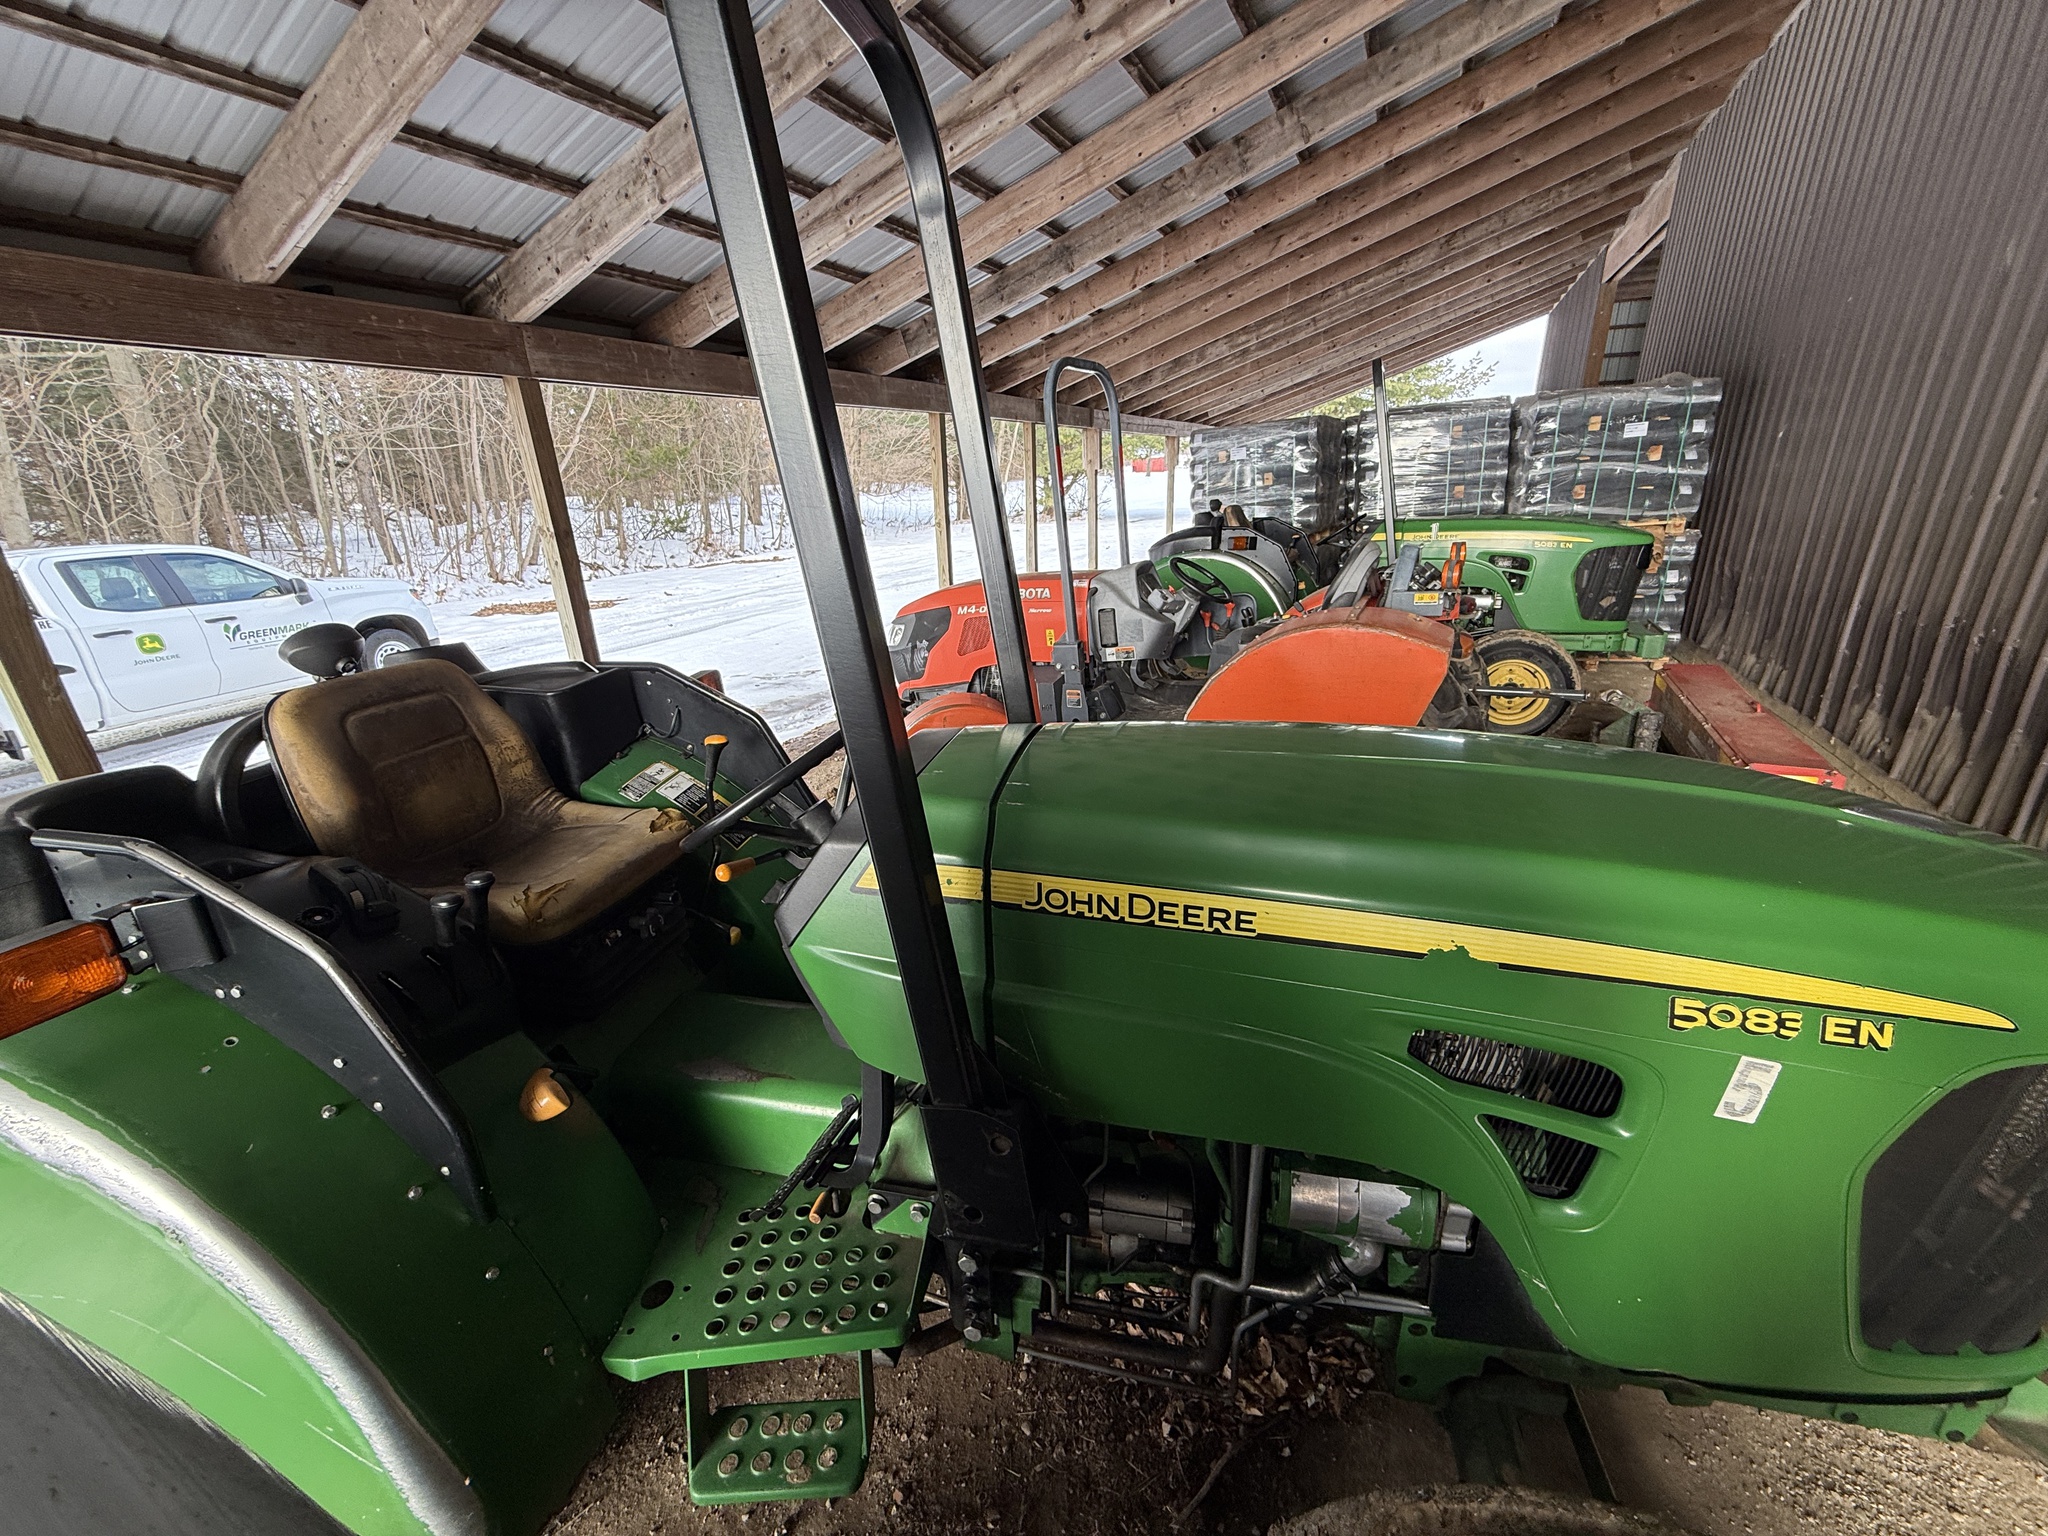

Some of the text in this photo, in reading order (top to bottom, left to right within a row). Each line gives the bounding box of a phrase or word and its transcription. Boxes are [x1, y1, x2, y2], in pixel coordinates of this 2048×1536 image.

[957, 605, 988, 615] M4-0
[1019, 587, 1051, 600] BOTA
[134, 653, 181, 666] JOHN DEERE
[1023, 881, 1258, 935] JOHN DEERE
[1670, 996, 1895, 1052] 5083 EN
[1723, 1060, 1775, 1118] 5
